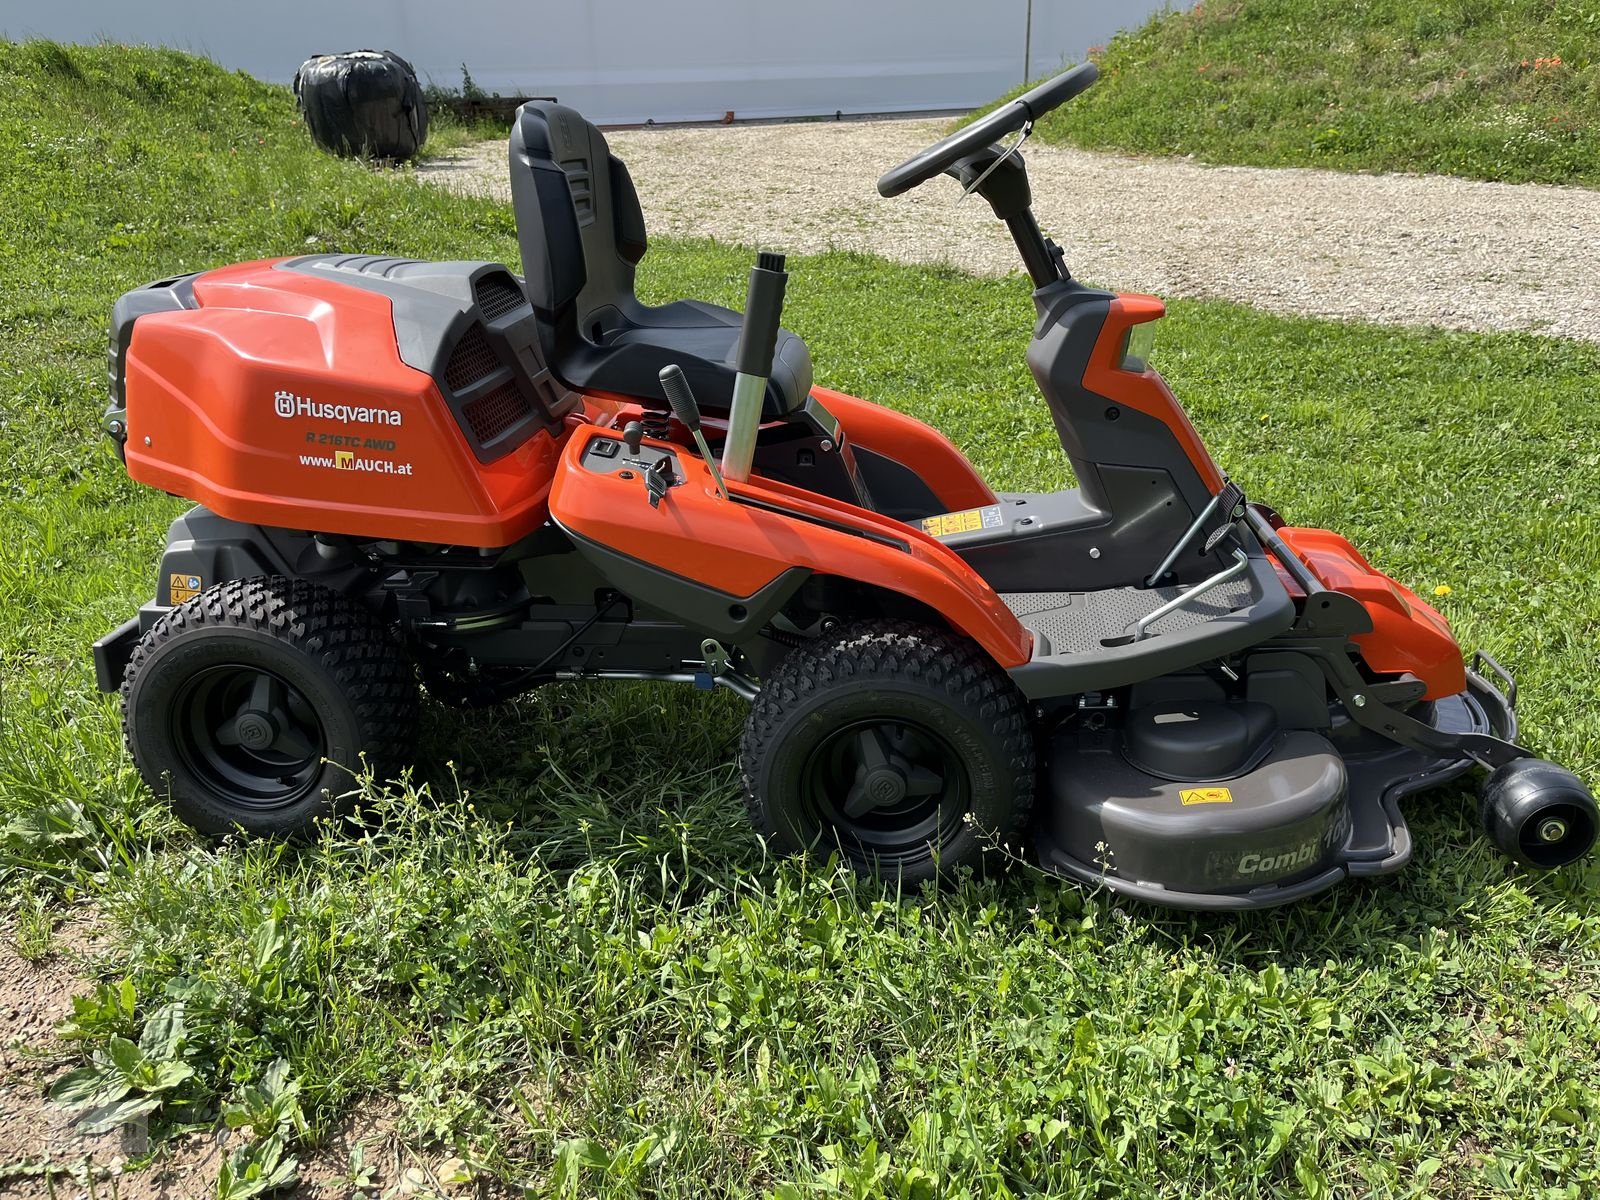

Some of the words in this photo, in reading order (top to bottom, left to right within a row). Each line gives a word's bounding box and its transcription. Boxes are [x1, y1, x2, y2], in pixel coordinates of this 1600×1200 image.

[296, 396, 402, 426] Husqvarna
[305, 432, 315, 443] R
[319, 433, 360, 447] 216TC
[363, 437, 396, 450] AWD
[299, 455, 412, 475] www.MAUCH.at
[1238, 841, 1318, 874] Combi
